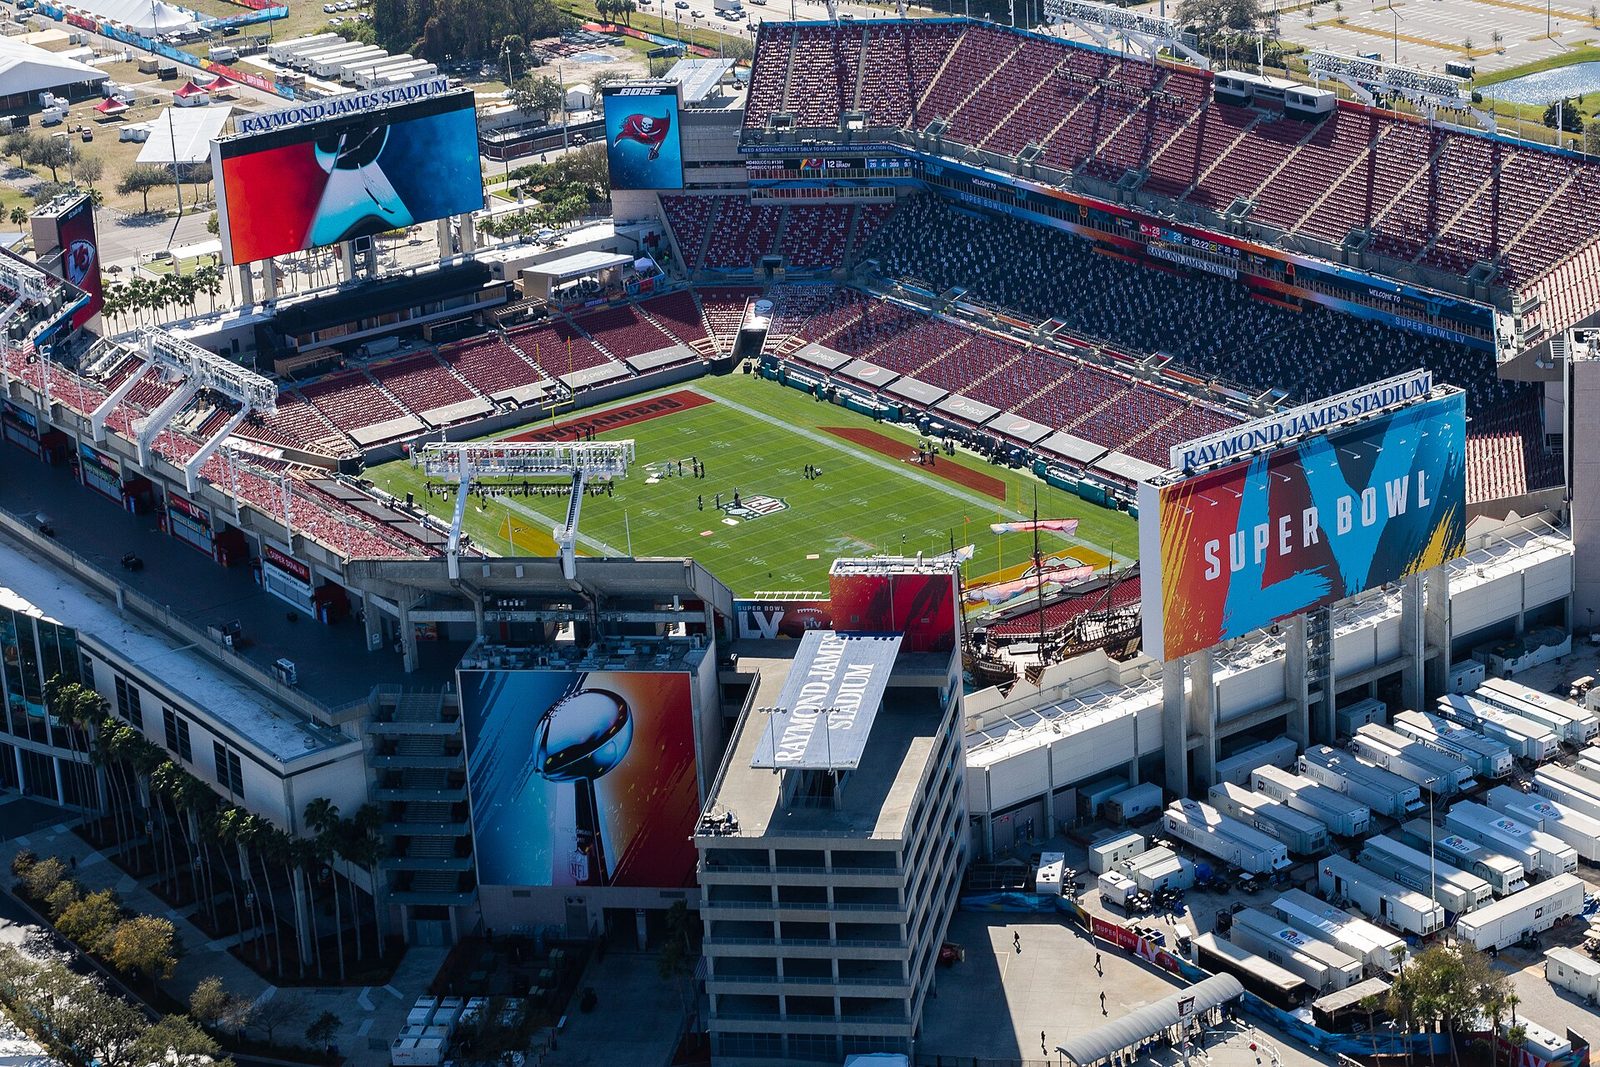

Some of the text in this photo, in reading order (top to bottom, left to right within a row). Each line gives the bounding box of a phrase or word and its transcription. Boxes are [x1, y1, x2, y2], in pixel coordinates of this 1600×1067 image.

[612, 87, 666, 96] BOSE
[242, 79, 448, 133] RAYMOND JAMES STADIUM
[827, 160, 835, 168] 12
[960, 192, 981, 204] SUPER
[984, 199, 1002, 211] BOWL
[1368, 288, 1401, 303] WELCOME TO
[1395, 317, 1465, 343] SUPER BOWL LV
[1183, 376, 1430, 471] RAYMOND JAMES STADIUM
[1204, 470, 1430, 581] SUPER BOWL
[738, 611, 785, 639] LV
[775, 632, 850, 761] RAYMOND JAMES
[827, 663, 875, 730] STADIUM
[570, 862, 585, 878] NFL
[1095, 924, 1136, 946] SUPER BOWL
